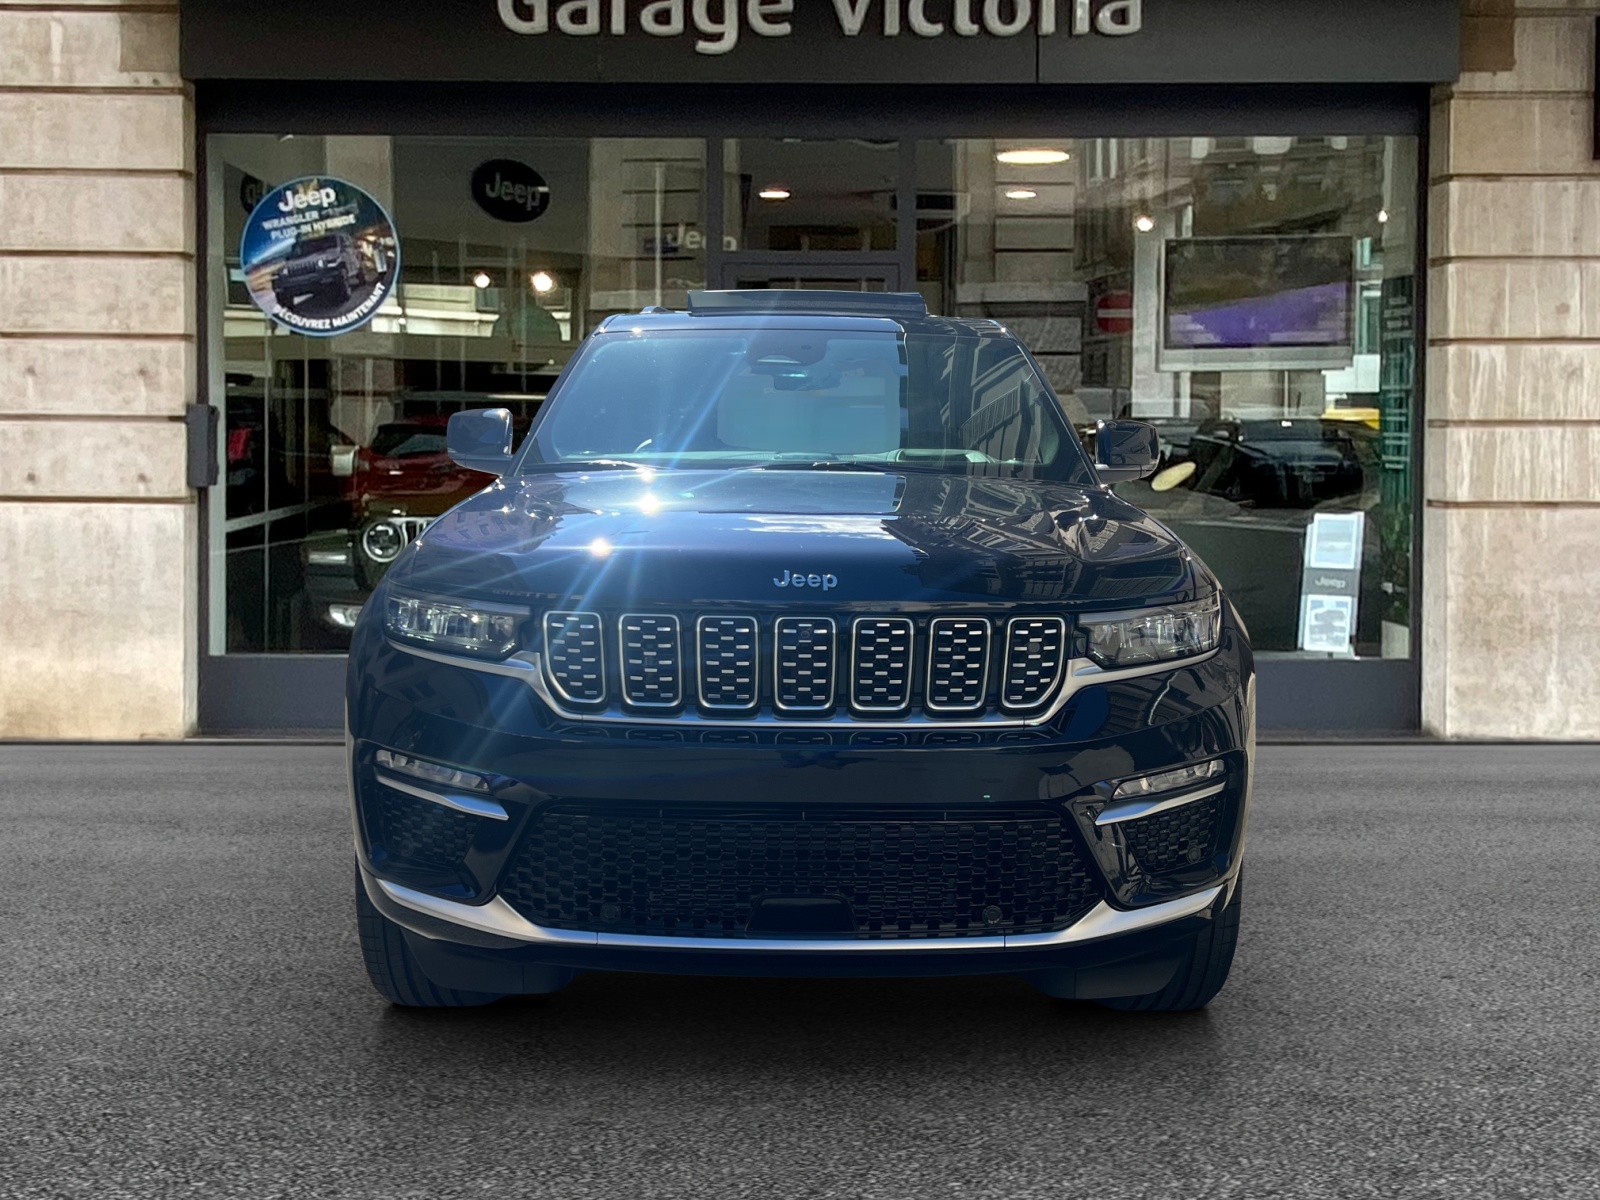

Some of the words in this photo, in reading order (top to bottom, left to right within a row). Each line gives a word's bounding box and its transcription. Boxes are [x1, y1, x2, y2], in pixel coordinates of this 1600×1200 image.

[497, 0, 795, 55] Garage
[278, 187, 336, 212] Jeep
[485, 172, 541, 212] Jeep
[262, 210, 320, 231] WRANGLER
[270, 223, 313, 241] PLUG-IN
[272, 304, 331, 329] DÉCOUVREZ
[331, 282, 386, 328] MAINTENANT
[773, 569, 838, 591] Jeep
[1315, 576, 1347, 589] Jeep
